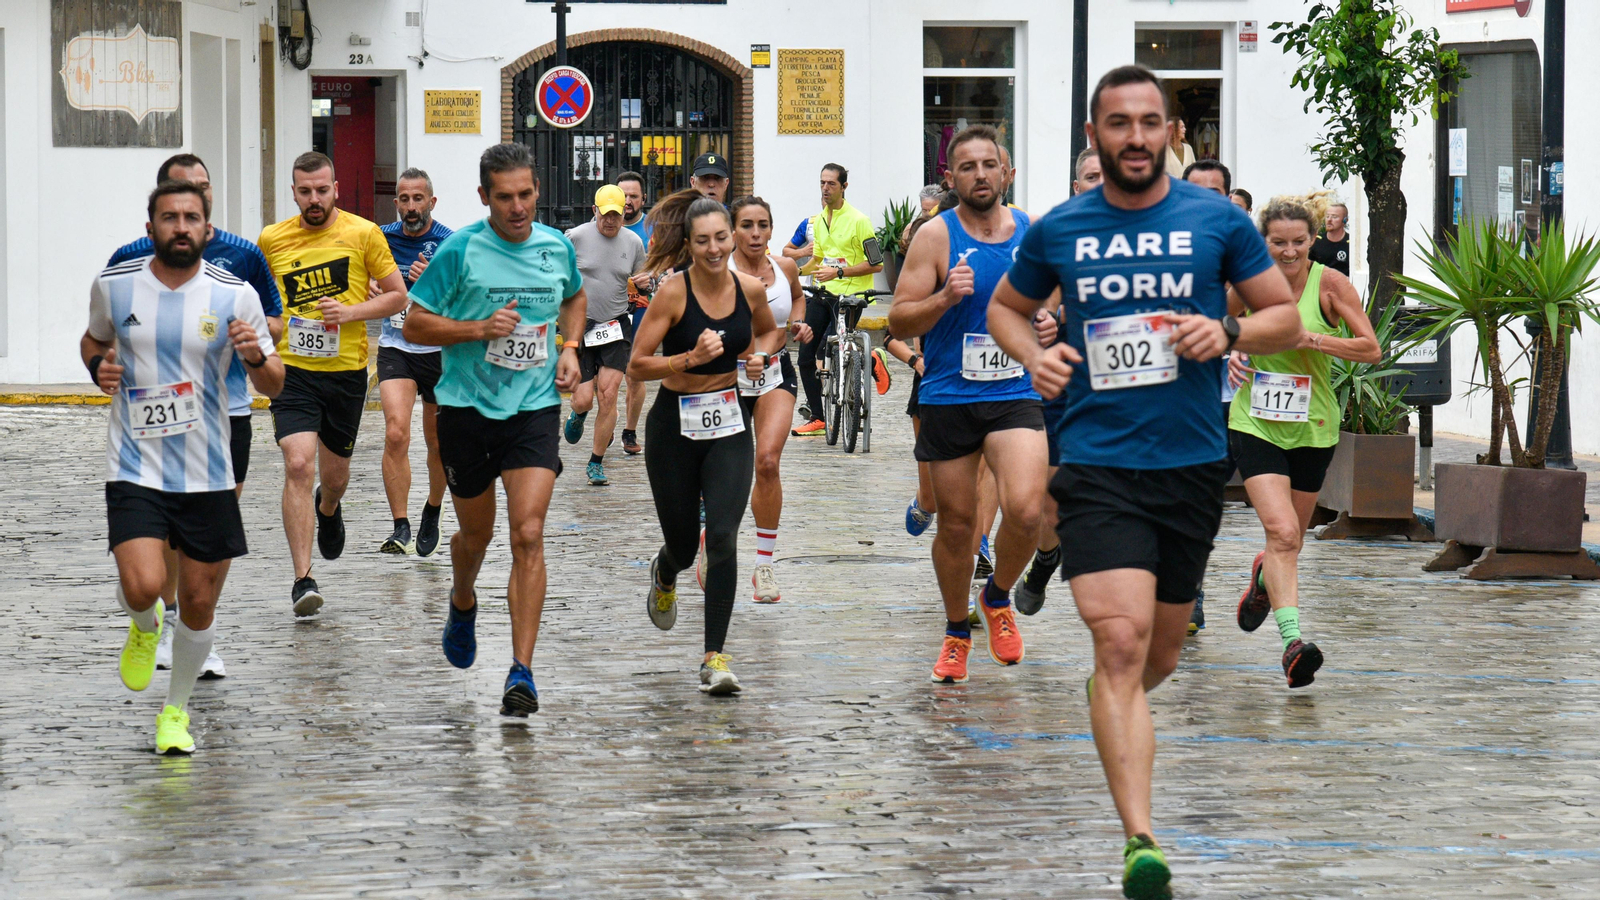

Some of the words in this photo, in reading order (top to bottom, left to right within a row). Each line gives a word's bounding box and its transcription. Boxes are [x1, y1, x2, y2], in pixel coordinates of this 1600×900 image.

[119, 60, 155, 83] Bliss
[544, 72, 558, 84] EXCEPTO
[572, 72, 586, 86] DESCARGA
[321, 82, 352, 91] EURO
[431, 97, 474, 108] LABORATORIO
[1075, 230, 1193, 262] RARE
[293, 267, 332, 292] XIII
[1076, 273, 1194, 302] FORM
[491, 295, 505, 304] La
[519, 294, 555, 304] Herrería
[298, 332, 324, 349] 385
[596, 330, 608, 340] 86
[504, 339, 536, 359] 330
[1106, 341, 1153, 370] 302
[979, 351, 1009, 369] 140
[1263, 389, 1294, 410] 117
[143, 402, 178, 425] 231
[702, 409, 722, 428] 66
